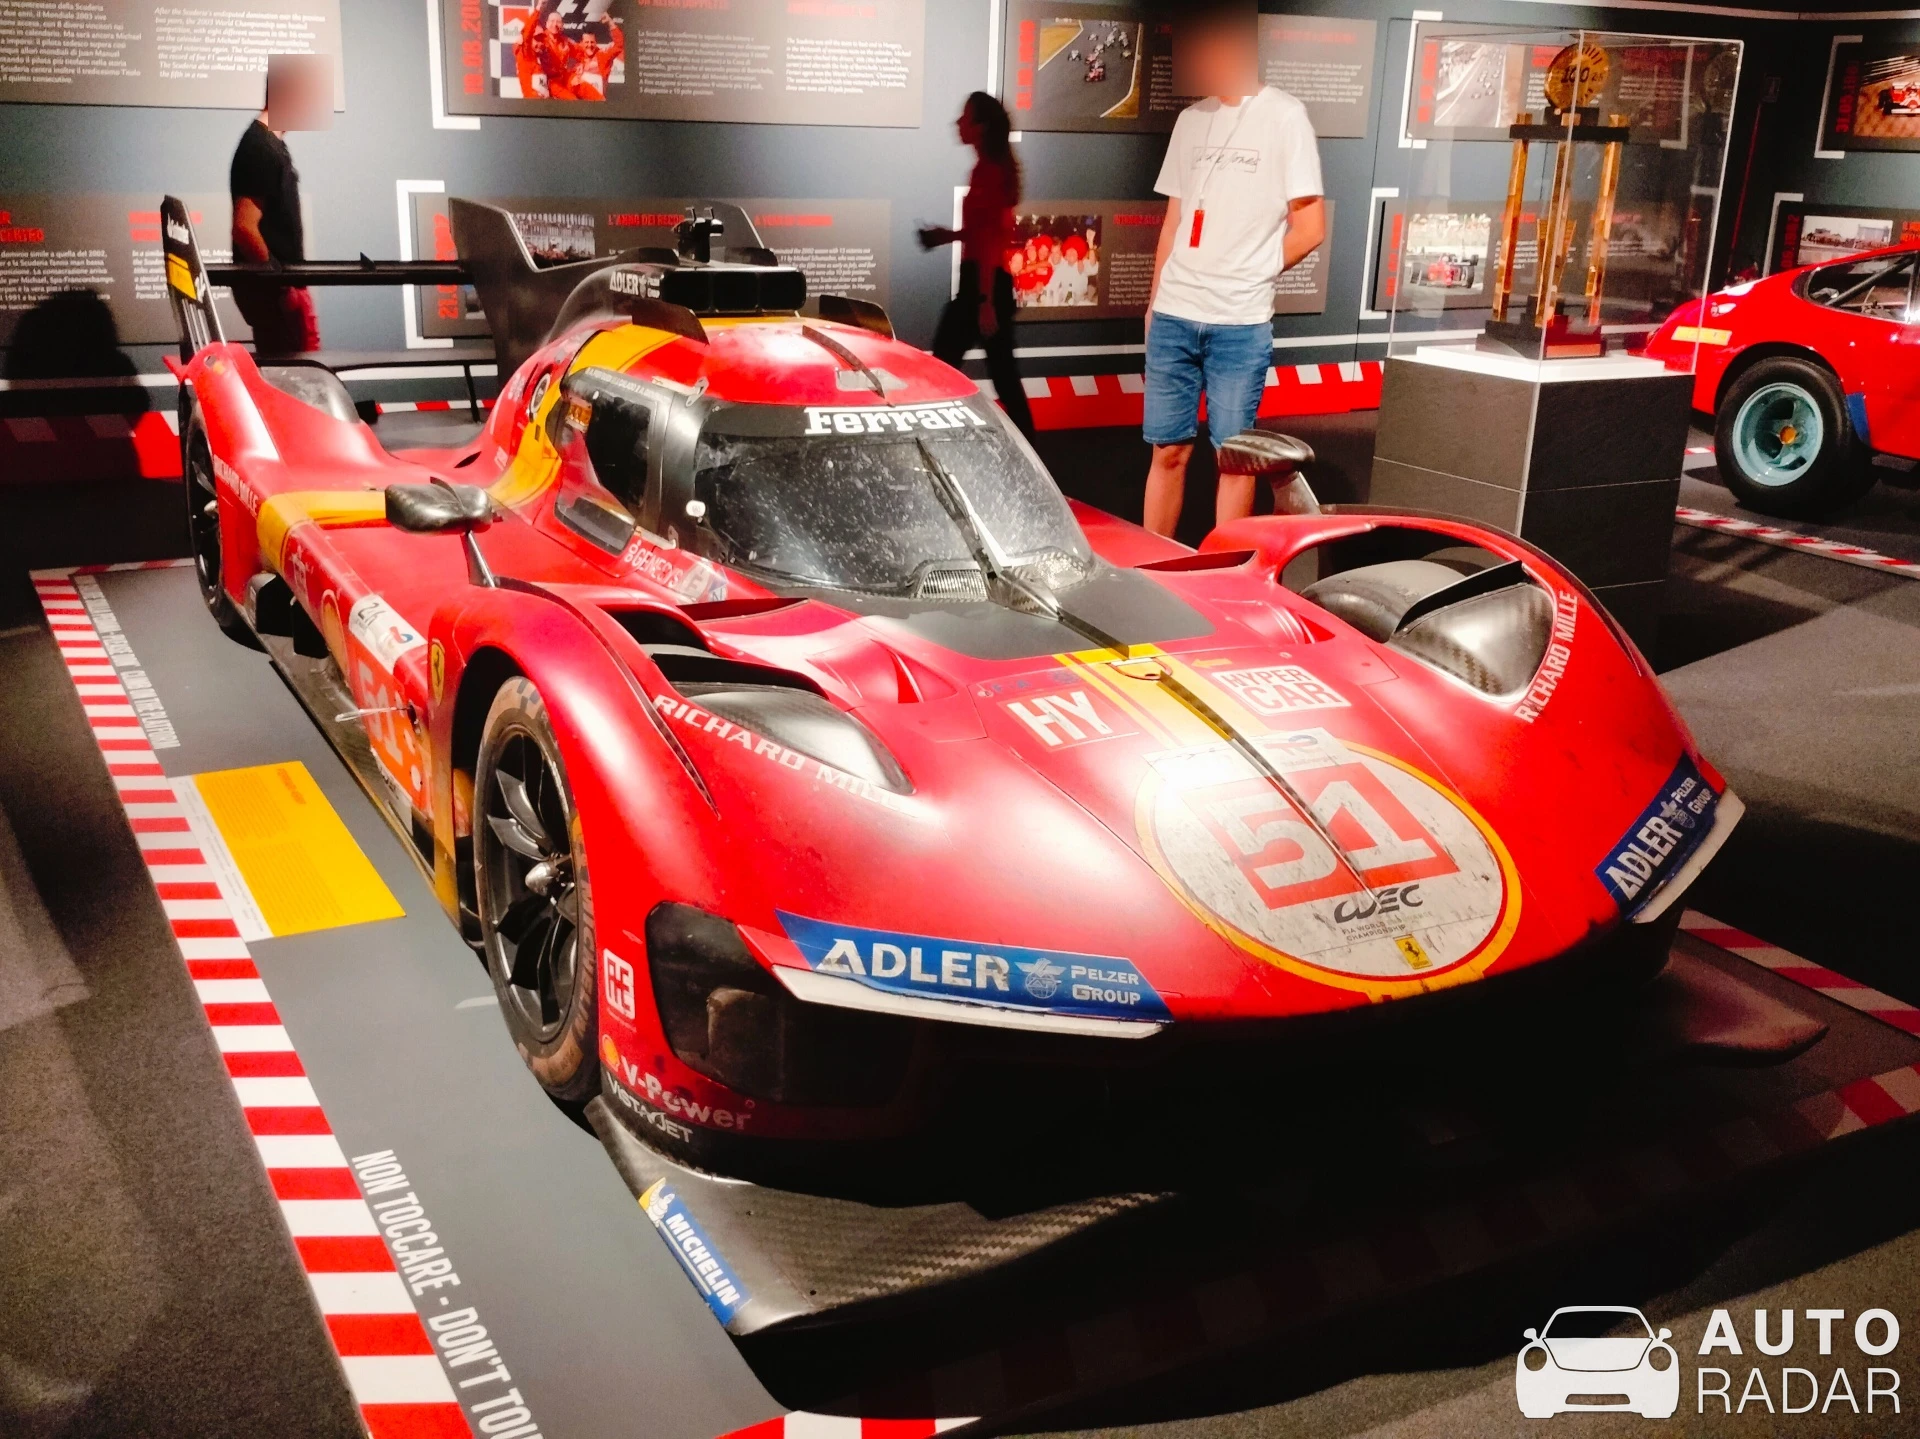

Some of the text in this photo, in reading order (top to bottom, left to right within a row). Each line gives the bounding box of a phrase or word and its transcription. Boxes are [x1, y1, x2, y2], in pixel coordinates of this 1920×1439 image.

[609, 271, 639, 296] ADLER
[804, 400, 987, 435] Ferrari
[1220, 668, 1312, 688] HYPER
[1514, 590, 1579, 723] RICHARD MILLE
[1006, 690, 1114, 746] HY
[1242, 682, 1342, 709] CAR
[653, 694, 805, 771] RICHARD
[1688, 787, 1713, 815] GROUP
[1199, 779, 1437, 891] 51
[1605, 814, 1683, 900] ADLER
[1333, 883, 1424, 924] WEC
[1357, 921, 1387, 932] WORLD
[1346, 923, 1406, 942] CHAMPIONSHIP
[812, 938, 1010, 992] ADLER
[1071, 965, 1139, 985] PELZER
[1072, 984, 1141, 1005] GROUP
[621, 1055, 751, 1130] V-Power
[352, 1149, 411, 1195] NON
[373, 1191, 461, 1296] TOCCARE
[665, 1213, 740, 1306] MICHELIN
[428, 1306, 511, 1389] DON'T
